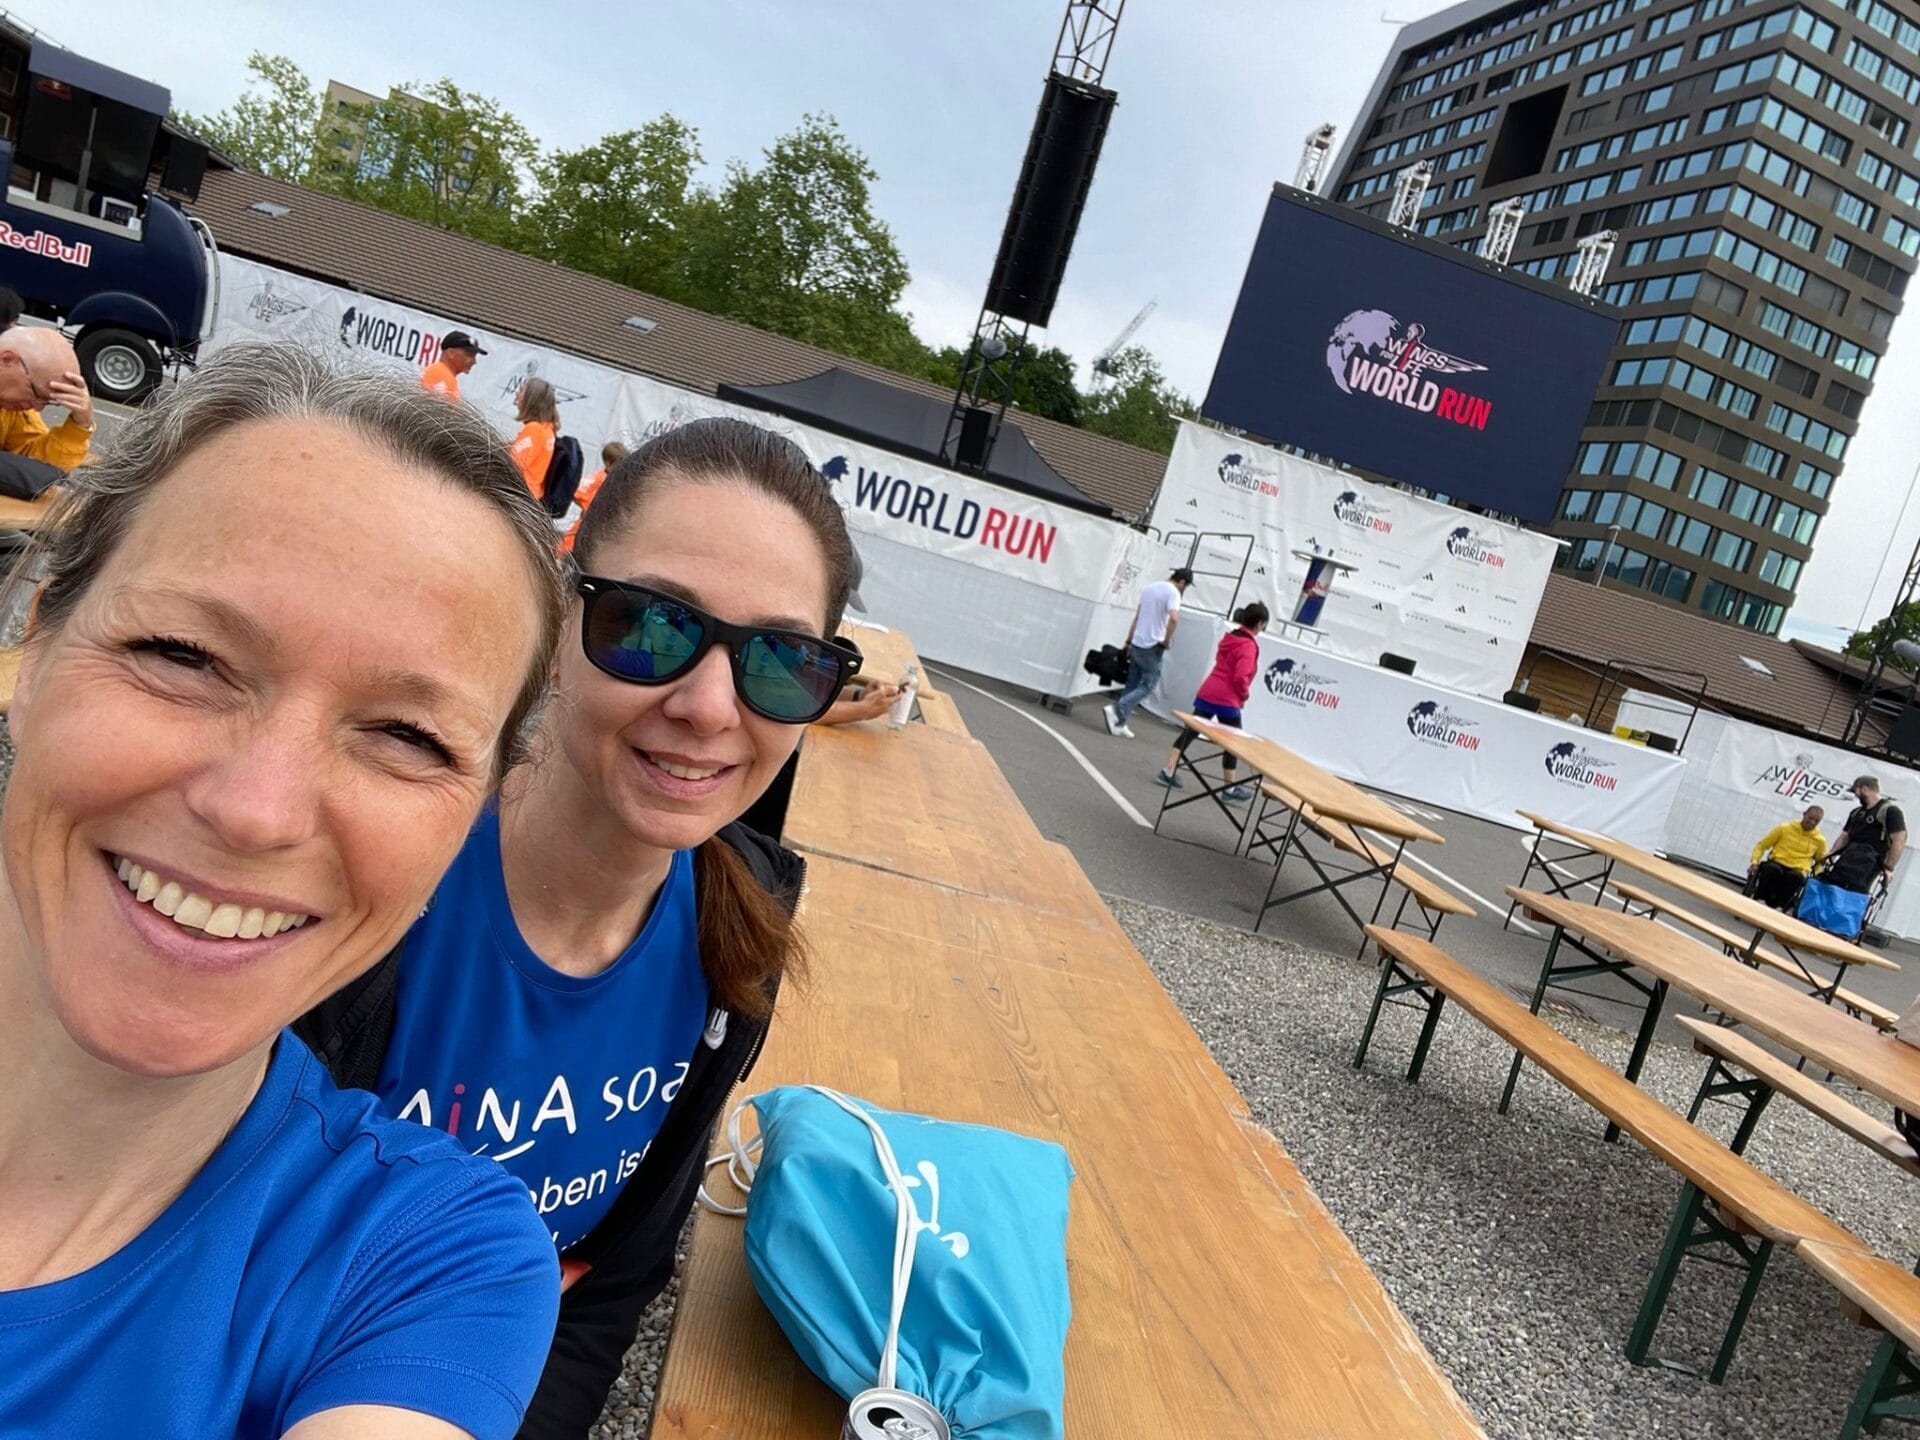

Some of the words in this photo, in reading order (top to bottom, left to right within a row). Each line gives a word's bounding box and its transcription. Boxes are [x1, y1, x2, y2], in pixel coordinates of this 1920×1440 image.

[42, 234, 92, 268] Bull
[356, 313, 421, 362] WORLD
[1388, 336, 1449, 369] WINGS
[1389, 354, 1427, 378] LIFE
[1350, 356, 1440, 413] WORLD
[1436, 387, 1492, 431] RUN
[1226, 470, 1260, 491] WORLD
[1258, 481, 1280, 498] RUN
[855, 466, 981, 540] WORLD
[980, 507, 1057, 564] RUN
[1341, 508, 1374, 528] WORLD
[1372, 518, 1392, 534] RUN
[1454, 543, 1487, 563] WORLD
[1485, 553, 1505, 568] RUN
[1275, 679, 1315, 702] WORLD
[1314, 691, 1340, 709] RUN
[1417, 721, 1457, 744] WORLD
[1455, 732, 1480, 751] RUN
[1555, 761, 1594, 784] WORLD
[1593, 773, 1617, 791] RUN
[1774, 765, 1844, 796] WINGS
[1774, 781, 1817, 803] LIFE
